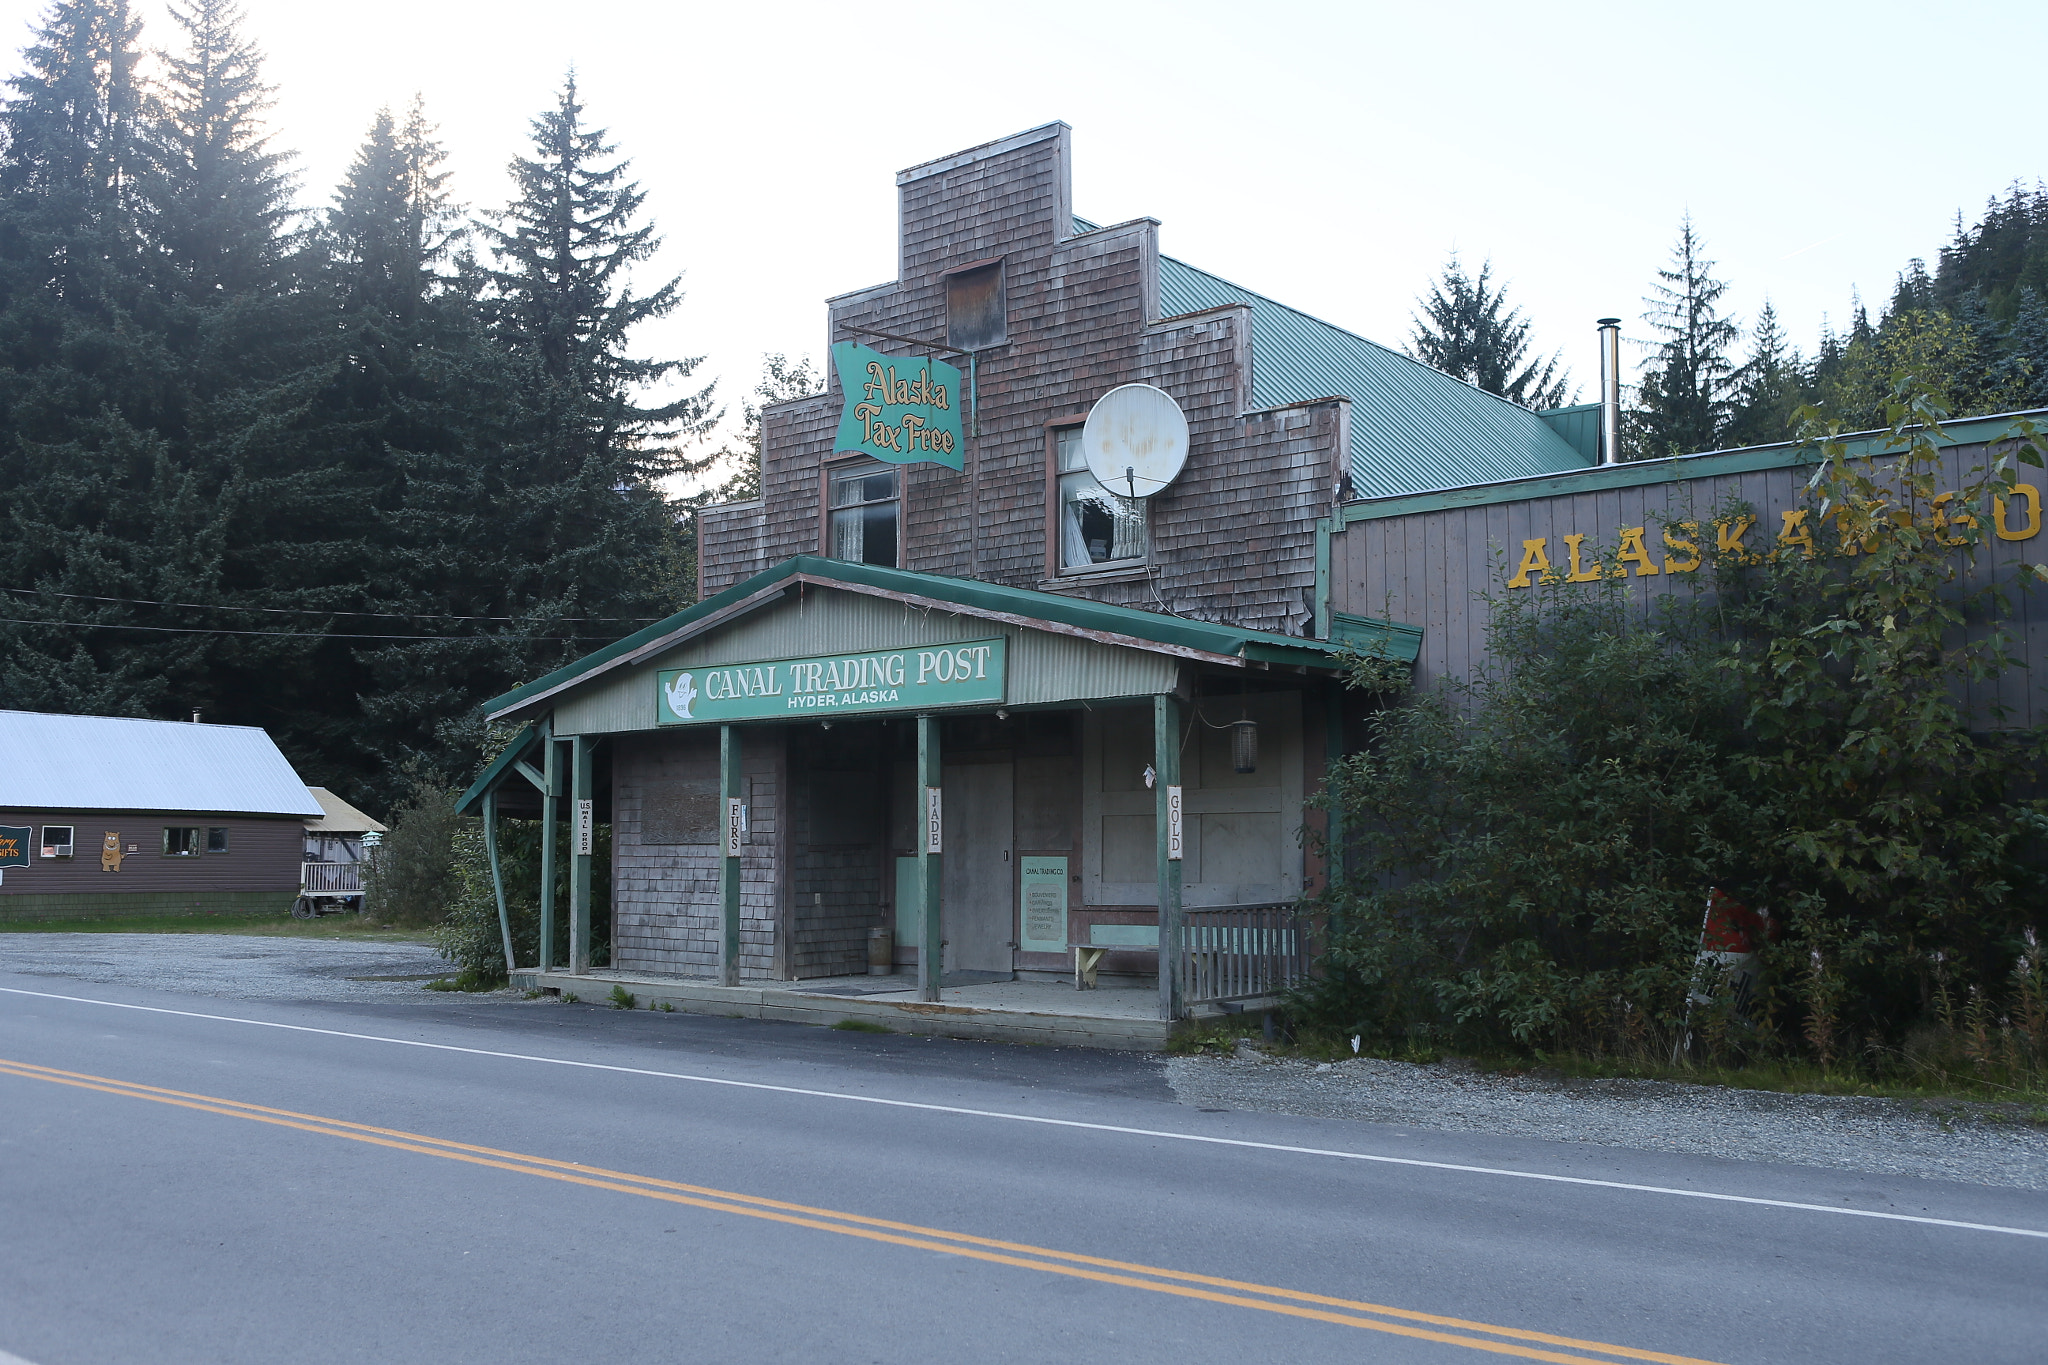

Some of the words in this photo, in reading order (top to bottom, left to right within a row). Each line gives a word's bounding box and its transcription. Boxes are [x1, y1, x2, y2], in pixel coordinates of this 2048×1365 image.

[863, 361, 950, 411] Alaska
[854, 402, 903, 452] Tax
[901, 413, 955, 455] Free
[705, 666, 782, 700] CANAL
[790, 654, 905, 695] TRADING
[917, 646, 992, 685] POST
[787, 694, 839, 709] HYDER,
[842, 690, 899, 706] ALASKA
[731, 804, 739, 850] FURS
[930, 795, 939, 846] JADE
[1170, 795, 1180, 851] GOLD
